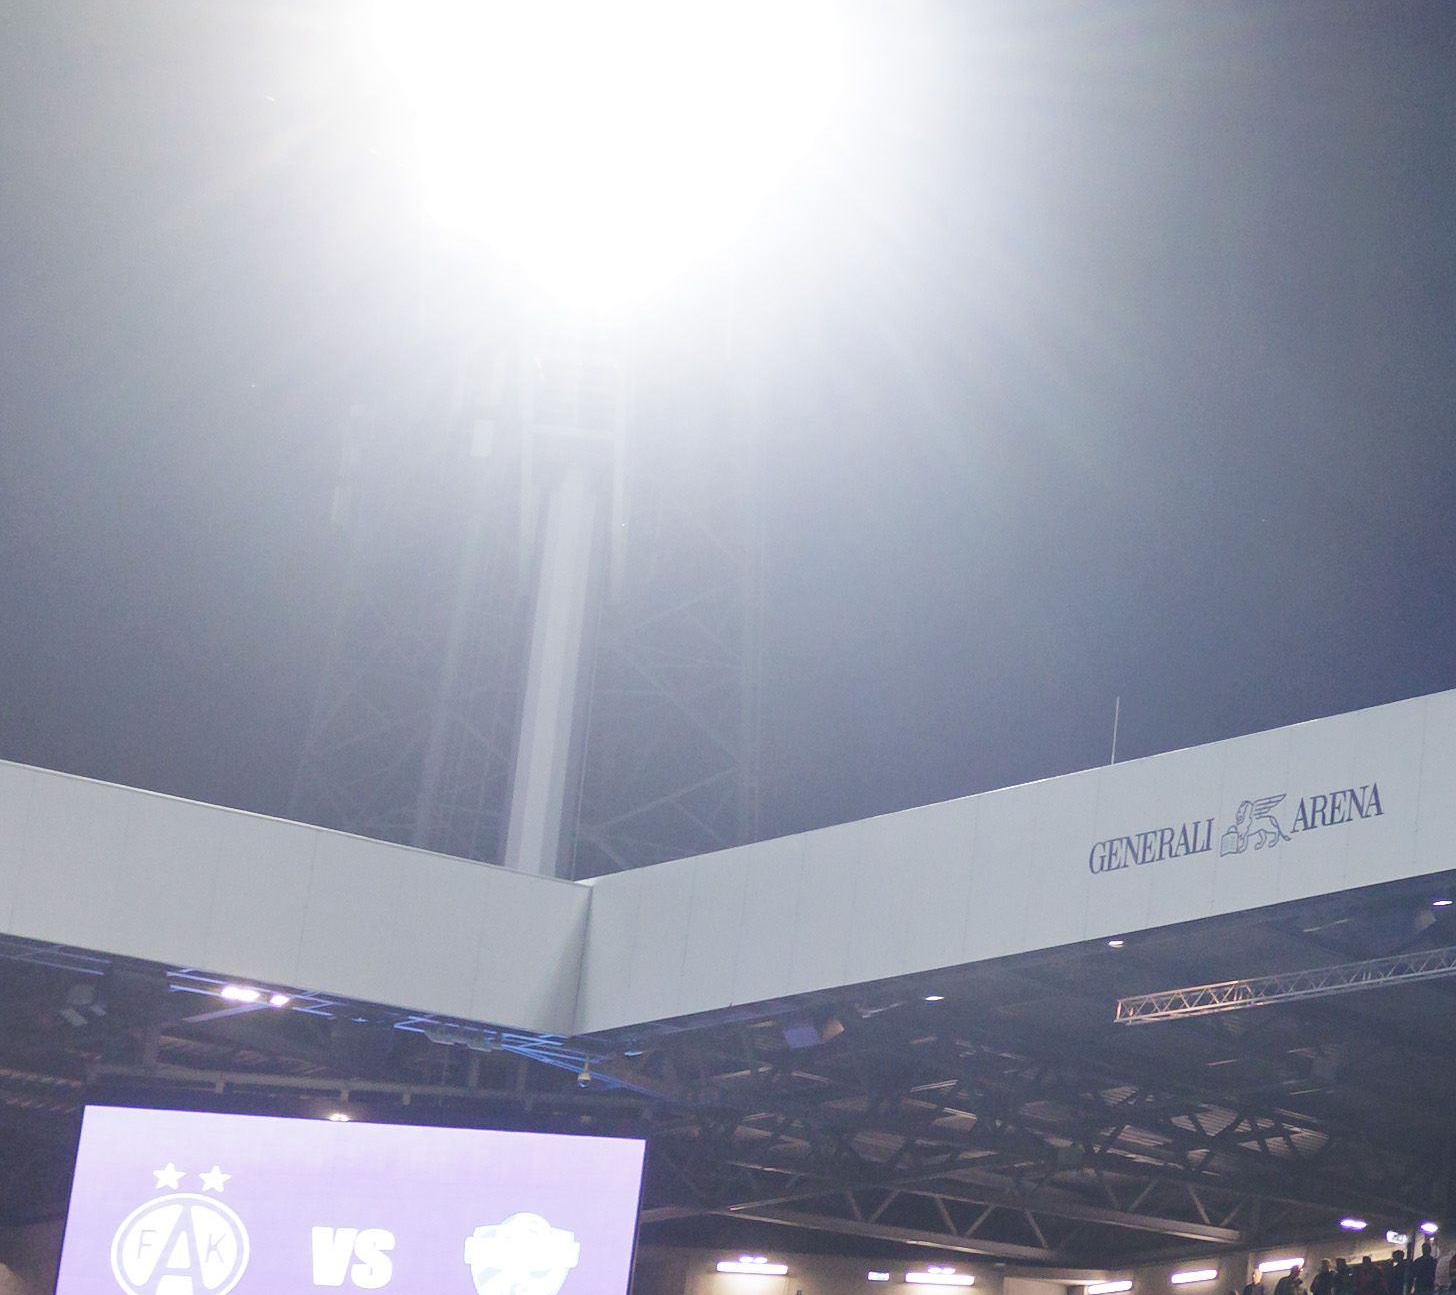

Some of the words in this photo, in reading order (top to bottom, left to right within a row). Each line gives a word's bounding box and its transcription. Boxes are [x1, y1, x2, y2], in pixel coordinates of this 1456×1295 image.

[1088, 818, 1214, 874] GENERALI
[1289, 782, 1384, 833] ARENA
[312, 1226, 396, 1289] VS
